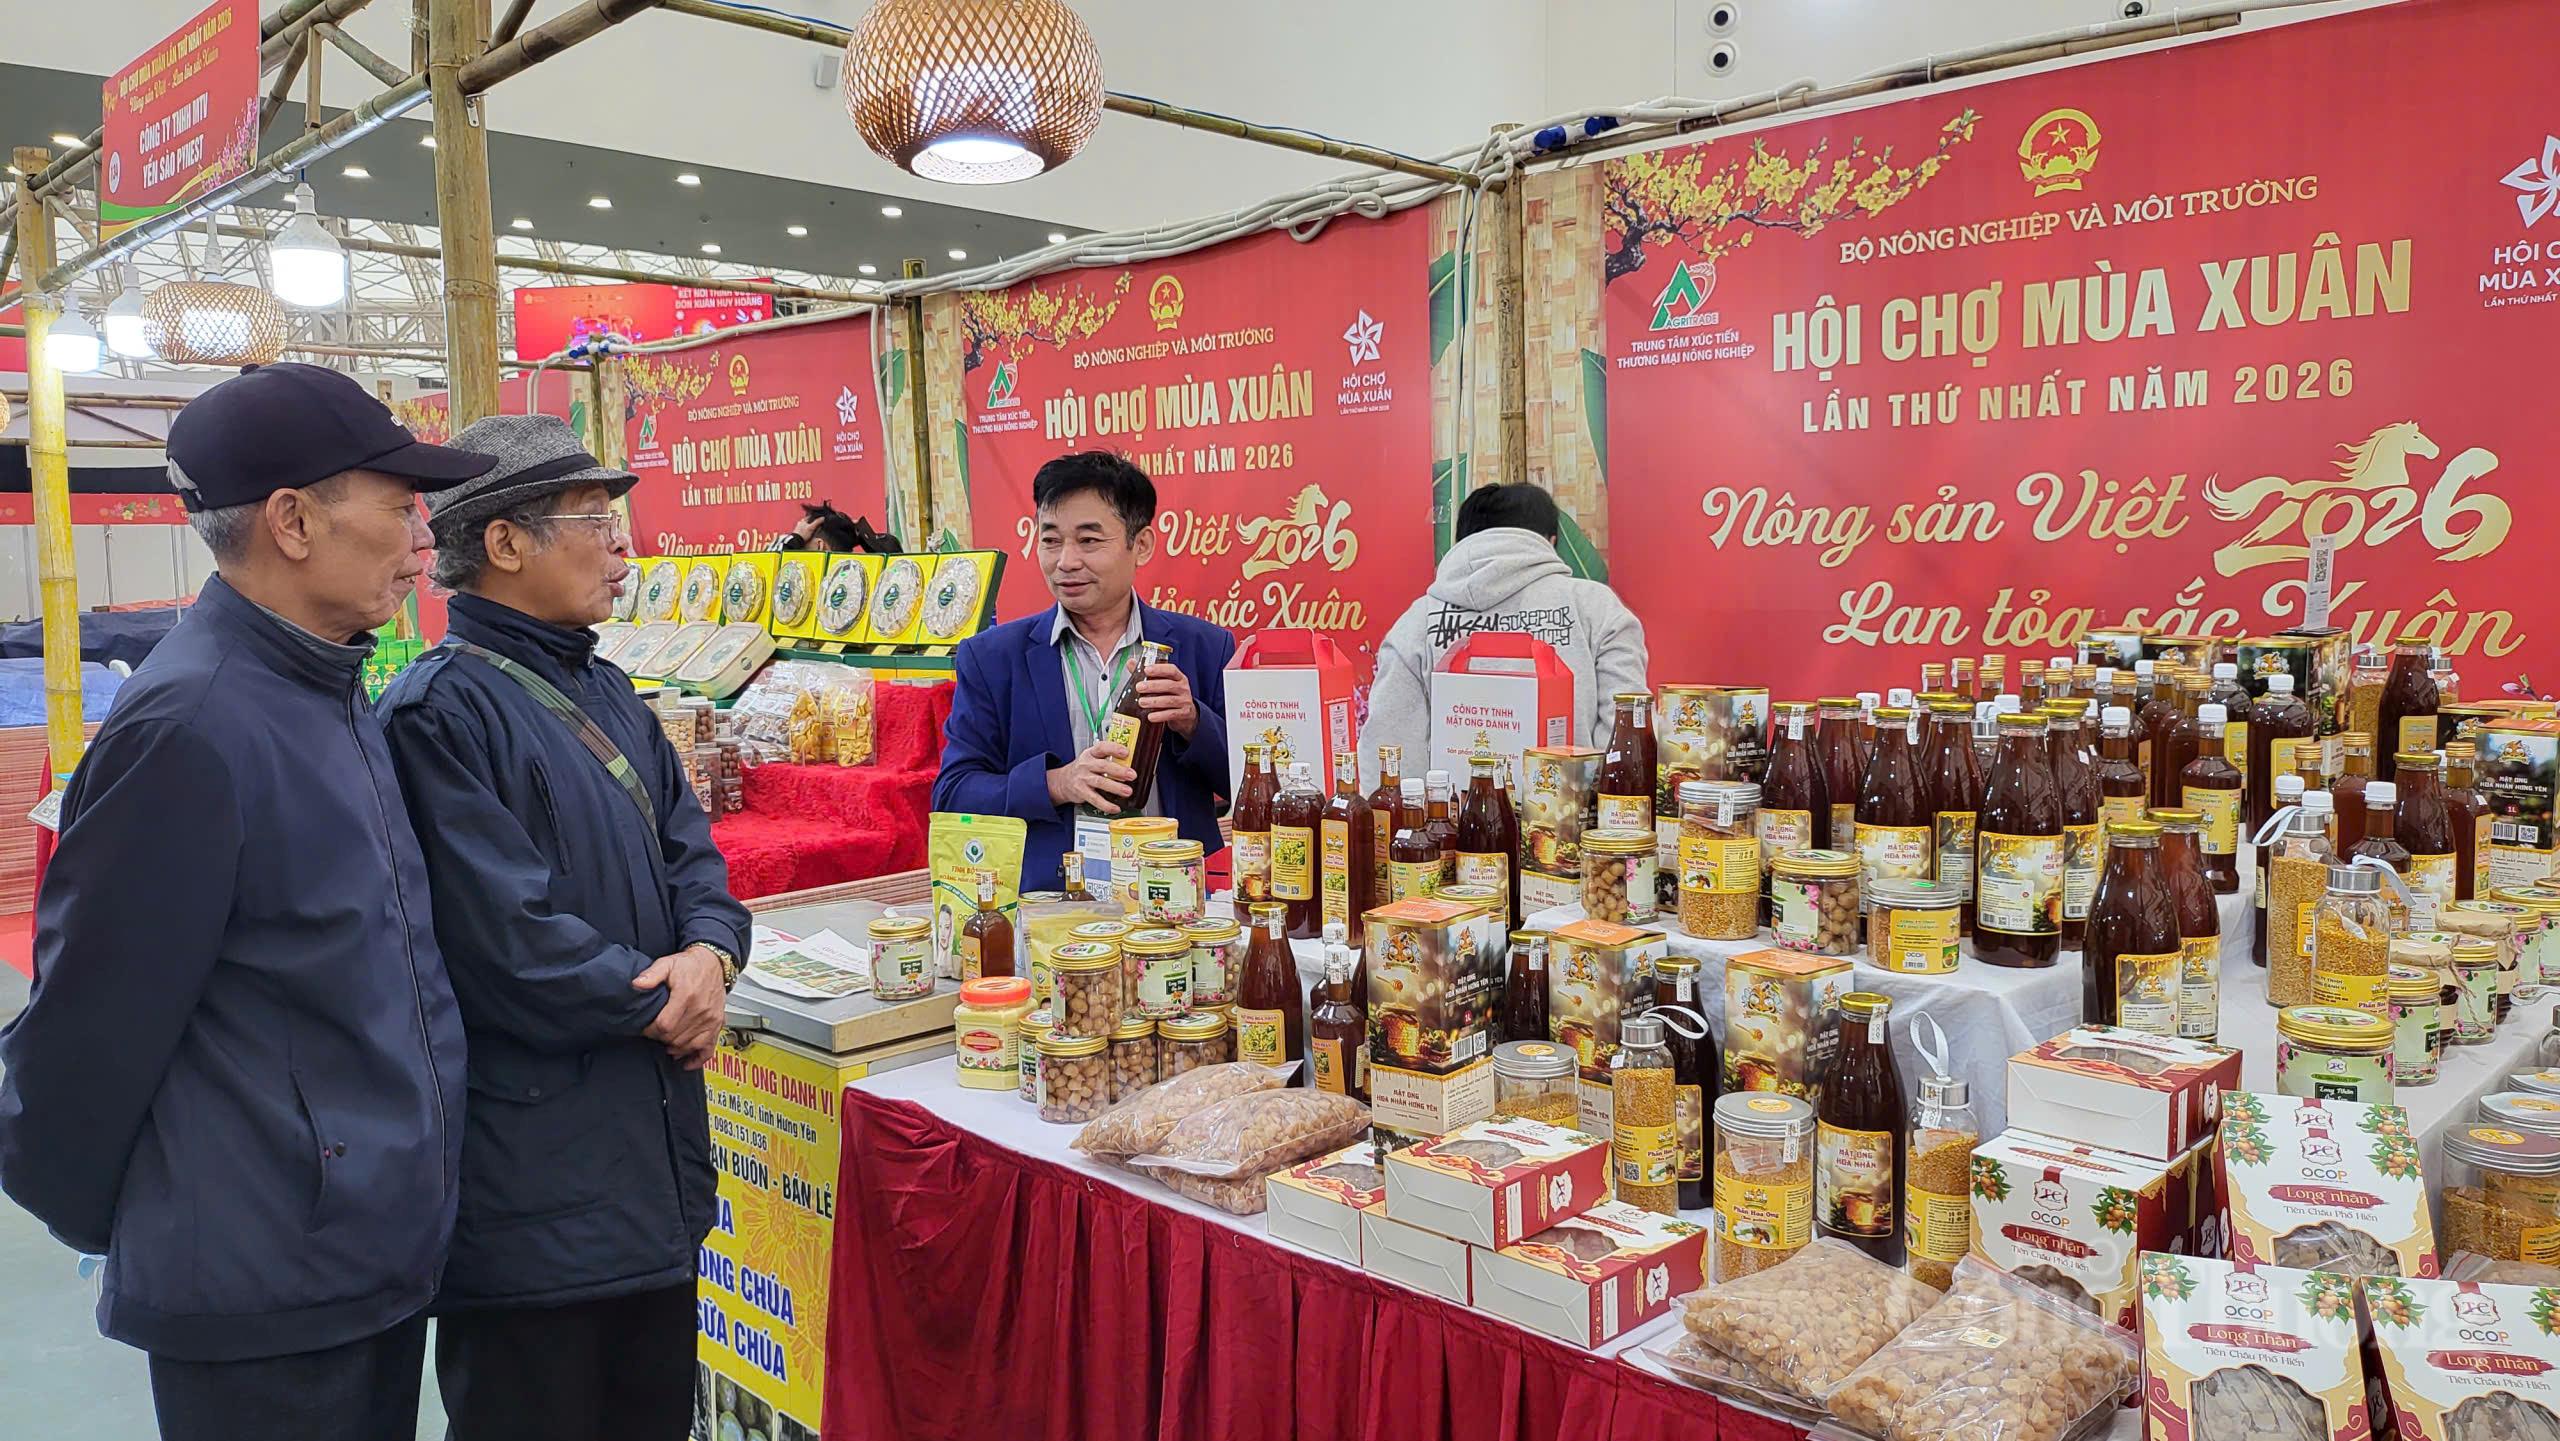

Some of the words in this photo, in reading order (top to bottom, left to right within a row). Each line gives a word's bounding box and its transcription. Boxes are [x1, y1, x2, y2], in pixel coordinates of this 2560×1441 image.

[139, 123, 160, 154] CÔNG
[162, 115, 171, 142] TY
[171, 107, 192, 138] TNHH
[192, 92, 209, 127] MTV
[143, 153, 158, 188] YẾN
[159, 148, 175, 181] SÀO
[1839, 237, 1874, 265] BỘ
[1879, 224, 1955, 261] NÔNG
[1959, 211, 2061, 249] NGHIỆP
[2066, 205, 2107, 231] VÀ
[2112, 194, 2174, 225] MÔI
[2180, 175, 2319, 216] TRƯỜNG
[2493, 239, 2540, 267] HỘI
[2478, 268, 2537, 293] MÙA
[1772, 293, 1862, 381] HỘI
[1880, 281, 2005, 368] CHỢ
[2021, 260, 2176, 348] MÙA
[2197, 231, 2413, 333] XUÂN
[2483, 295, 2506, 308] LẦN
[2506, 293, 2530, 305] THỨ
[2530, 291, 2559, 304] NHẤT
[1665, 312, 1719, 329] AGRITRADE
[1073, 350, 1090, 371] BỘ
[1091, 344, 1125, 368] NÔNG
[1125, 338, 1170, 363] NGHIỆP
[1172, 336, 1190, 356] VÀ
[1191, 333, 1217, 354] MÔI
[1219, 327, 1275, 350] TRƯỜNG
[1631, 340, 1666, 353] TRUNG
[1667, 335, 1690, 349] TÂM
[1691, 331, 1713, 346] XÚC
[1715, 328, 1740, 343] TIẾN
[1617, 354, 1659, 369] THƯƠNG
[1660, 352, 1681, 366] MẠI
[1682, 347, 1713, 362] NÔNG
[1714, 343, 1756, 360] NGHIỆP
[1044, 385, 1087, 447] HỘI
[1094, 381, 1148, 442] CHỢ
[1154, 374, 1222, 428] MÙA
[1227, 362, 1314, 423] XUÂN
[1803, 388, 1870, 433] LẦN
[1888, 384, 1962, 427] THỨ
[1979, 369, 2087, 421] NHẤT
[2108, 366, 2210, 412] NĂM
[2232, 358, 2354, 404] 2026
[698, 404, 717, 421] NÔNG
[672, 435, 697, 481] HỘI
[700, 435, 731, 477] CHỢ
[735, 428, 770, 470] MÙA
[775, 422, 822, 465] XUÂN
[1138, 448, 1185, 477] NHẤT
[1194, 446, 1236, 473] NĂM
[1244, 443, 1294, 470] 2026
[682, 482, 701, 507] LẦN
[704, 482, 723, 505] THỨ
[726, 479, 753, 504] NHẤT
[757, 479, 781, 502] NĂM
[785, 480, 812, 500] 2026
[1702, 486, 1875, 569] Nông
[1887, 483, 2005, 547] sản
[2016, 469, 2191, 556] Việt
[1158, 510, 1233, 565] Việt
[1205, 579, 1259, 629] sắc
[1263, 581, 1367, 632] Xuân
[1820, 580, 1971, 649] Lan
[1986, 586, 2102, 648] tỏa
[1245, 699, 1268, 709] CÔNG
[1270, 701, 1279, 709] TY
[1280, 701, 1300, 709] TNHH
[1257, 711, 1274, 720] ONG
[1275, 711, 1297, 720] DANH
[1452, 703, 1477, 716] CÔNG
[1479, 706, 1490, 716] TY
[1491, 708, 1514, 718] TNHH
[1446, 715, 1462, 728] MẬT
[1464, 718, 1484, 728] ONG
[1486, 720, 1511, 730] DANH
[1512, 721, 1521, 733] VỊ
[722, 1051, 748, 1087] MẬT
[751, 1063, 778, 1096] ONG
[780, 1074, 817, 1111] DANH
[820, 1087, 834, 1123] VỊ
[717, 1091, 727, 1108] xã
[776, 1112, 799, 1138] Hưng
[800, 1122, 817, 1144] Yên
[714, 1116, 768, 1151] 0983.151.036
[732, 1150, 769, 1191] BUÔN
[783, 1172, 811, 1210] BÁN
[815, 1182, 833, 1220] LẺ
[2301, 1167, 2348, 1181] OCOP
[2286, 1185, 2326, 1205] Long
[2031, 1210, 2070, 1227] OCOP
[2015, 1227, 2048, 1249] Long
[740, 1264, 795, 1327] CHÚA
[2224, 1305, 2274, 1320] OCOP
[2207, 1325, 2250, 1346] Long
[2459, 1329, 2509, 1343] OCOP
[733, 1319, 787, 1383] CHÚA
[2445, 1352, 2492, 1373] Long
